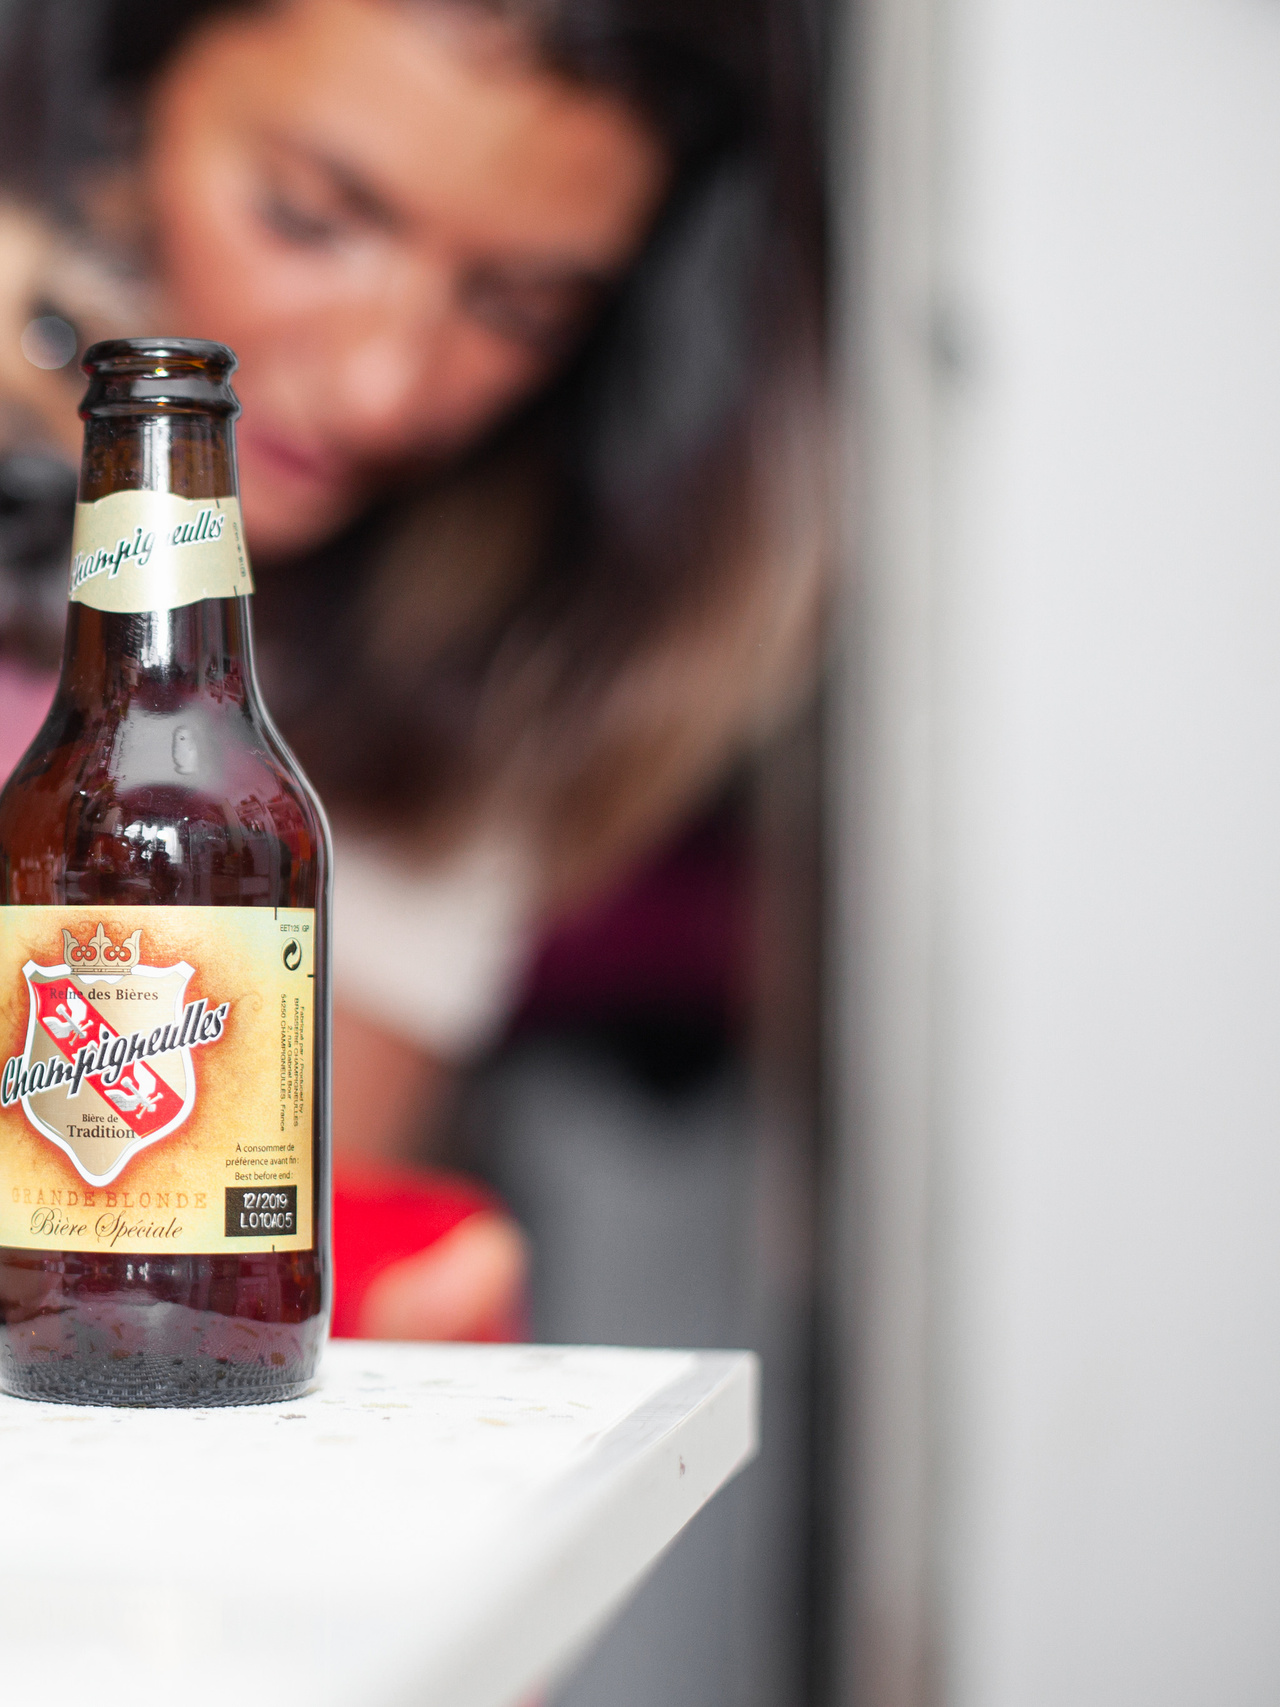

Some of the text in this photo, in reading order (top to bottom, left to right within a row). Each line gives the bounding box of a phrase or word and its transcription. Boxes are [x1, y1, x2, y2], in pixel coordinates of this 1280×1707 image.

[70, 510, 225, 592] hampigeulles
[50, 988, 158, 1000] Reine des Bières
[0, 1000, 228, 1106] Champigneulles
[82, 1114, 119, 1123] Bière de
[67, 1125, 135, 1138] Tradition
[243, 1144, 286, 1153] consommer
[286, 1143, 295, 1151] de
[225, 1156, 269, 1168] préférence
[269, 1158, 288, 1166] avant
[234, 1171, 252, 1181] Best
[253, 1170, 277, 1180] before
[11, 1187, 207, 1209] GRANDE BLONDE
[242, 1192, 289, 1209] 12/2019
[29, 1206, 183, 1248] Bière Spéciale
